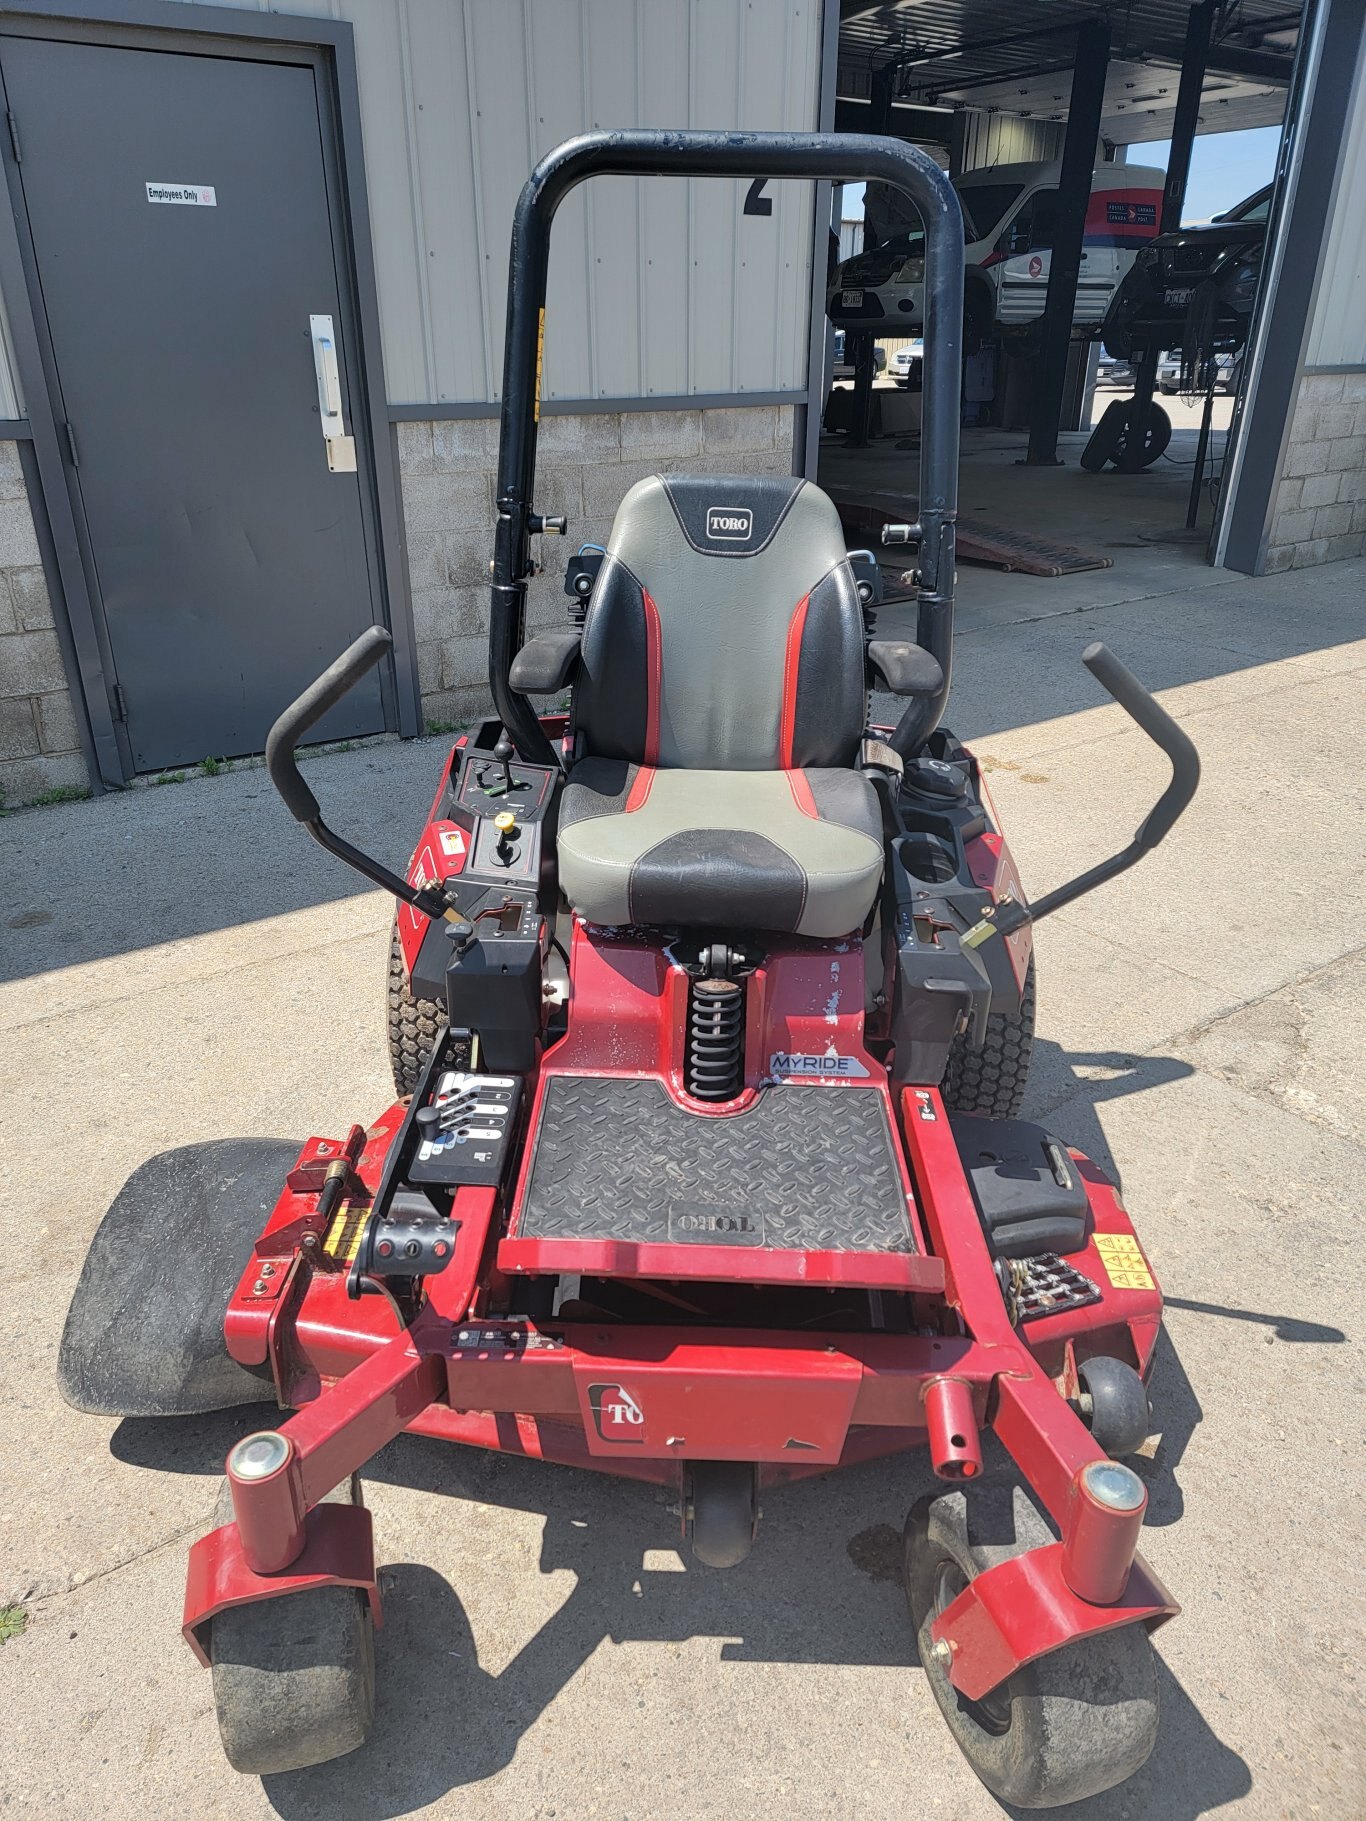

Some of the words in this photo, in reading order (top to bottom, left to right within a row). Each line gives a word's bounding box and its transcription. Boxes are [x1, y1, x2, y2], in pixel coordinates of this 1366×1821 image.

[148, 188, 183, 201] Employees
[184, 190, 198, 202] Only
[743, 178, 772, 216] 2
[710, 517, 748, 530] TORO
[677, 1215, 756, 1232] TORO
